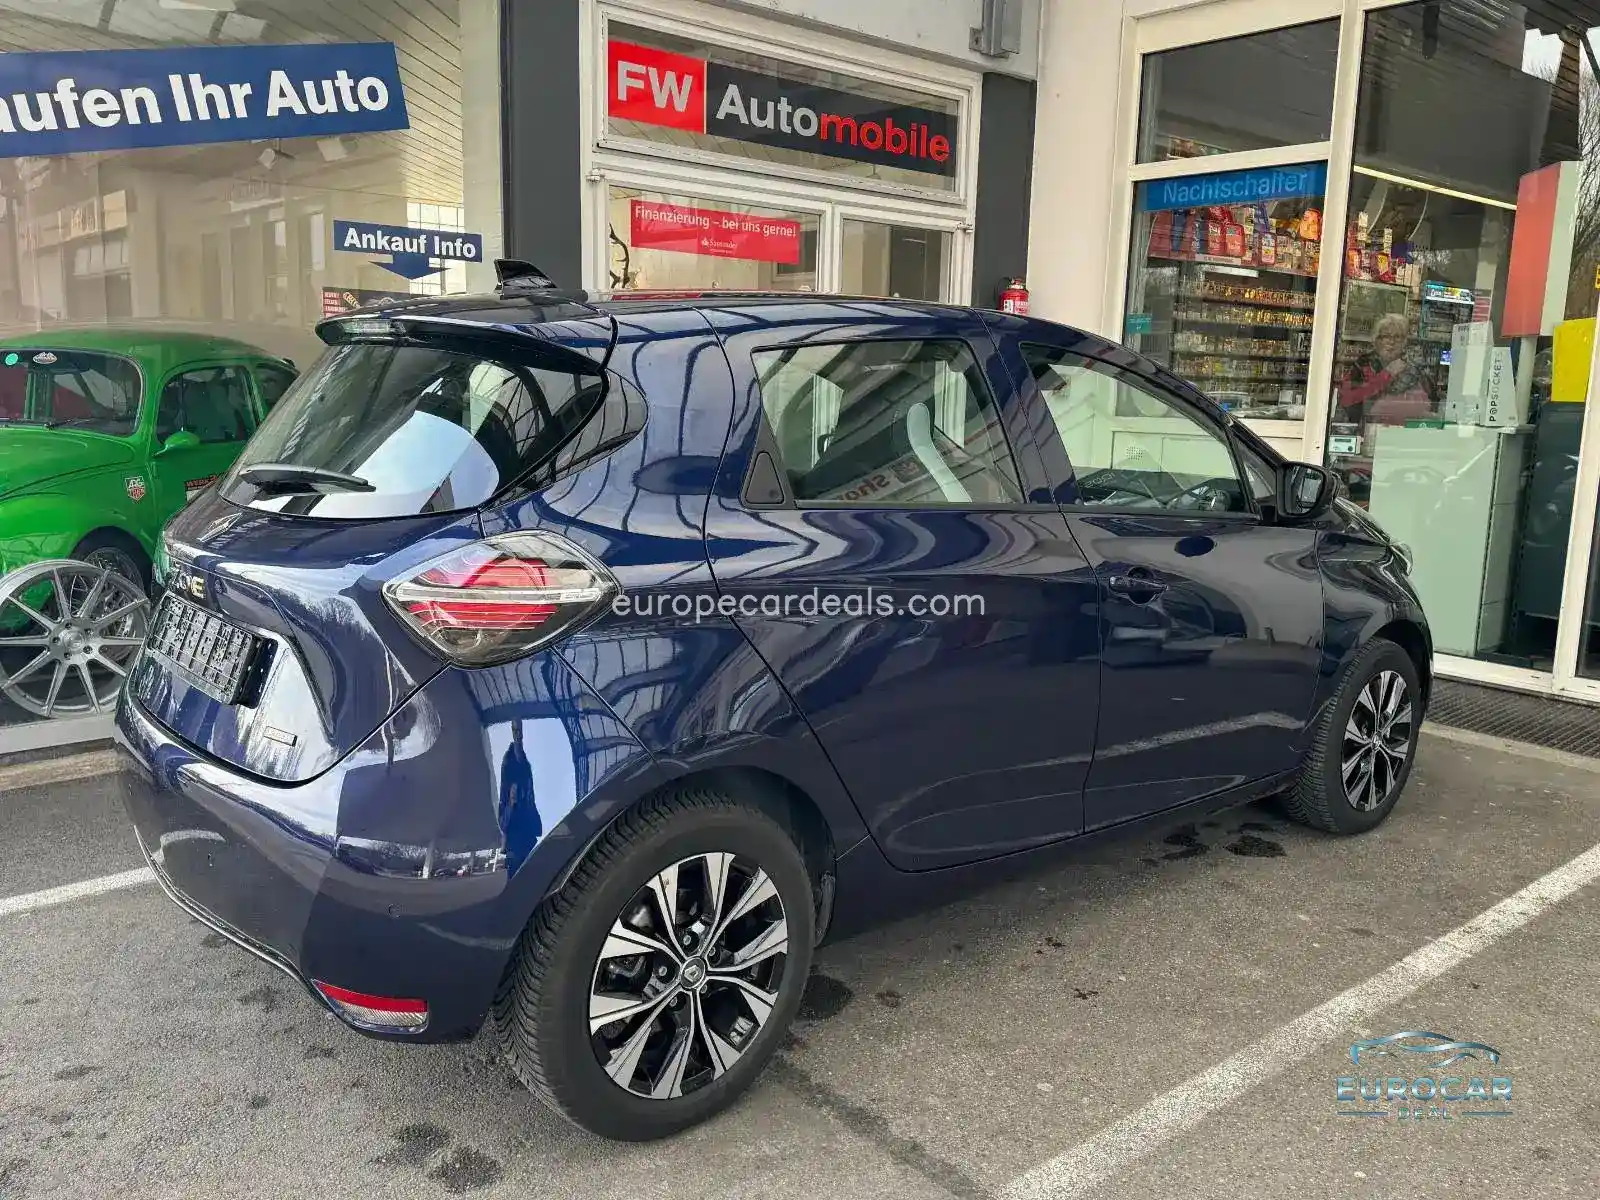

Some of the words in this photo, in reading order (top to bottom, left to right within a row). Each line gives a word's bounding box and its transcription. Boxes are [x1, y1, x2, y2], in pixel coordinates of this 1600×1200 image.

[168, 73, 252, 122] Ihr
[266, 70, 389, 117] Auto
[616, 60, 693, 112] FW
[715, 83, 950, 161] Automobile
[1163, 170, 1308, 204] Nachtschalter
[635, 205, 710, 229] Finanzierung
[722, 217, 738, 230] bei
[742, 222, 760, 232] uns
[763, 224, 797, 238] gerne!
[343, 227, 427, 253] Ankauf
[433, 235, 476, 258] Info
